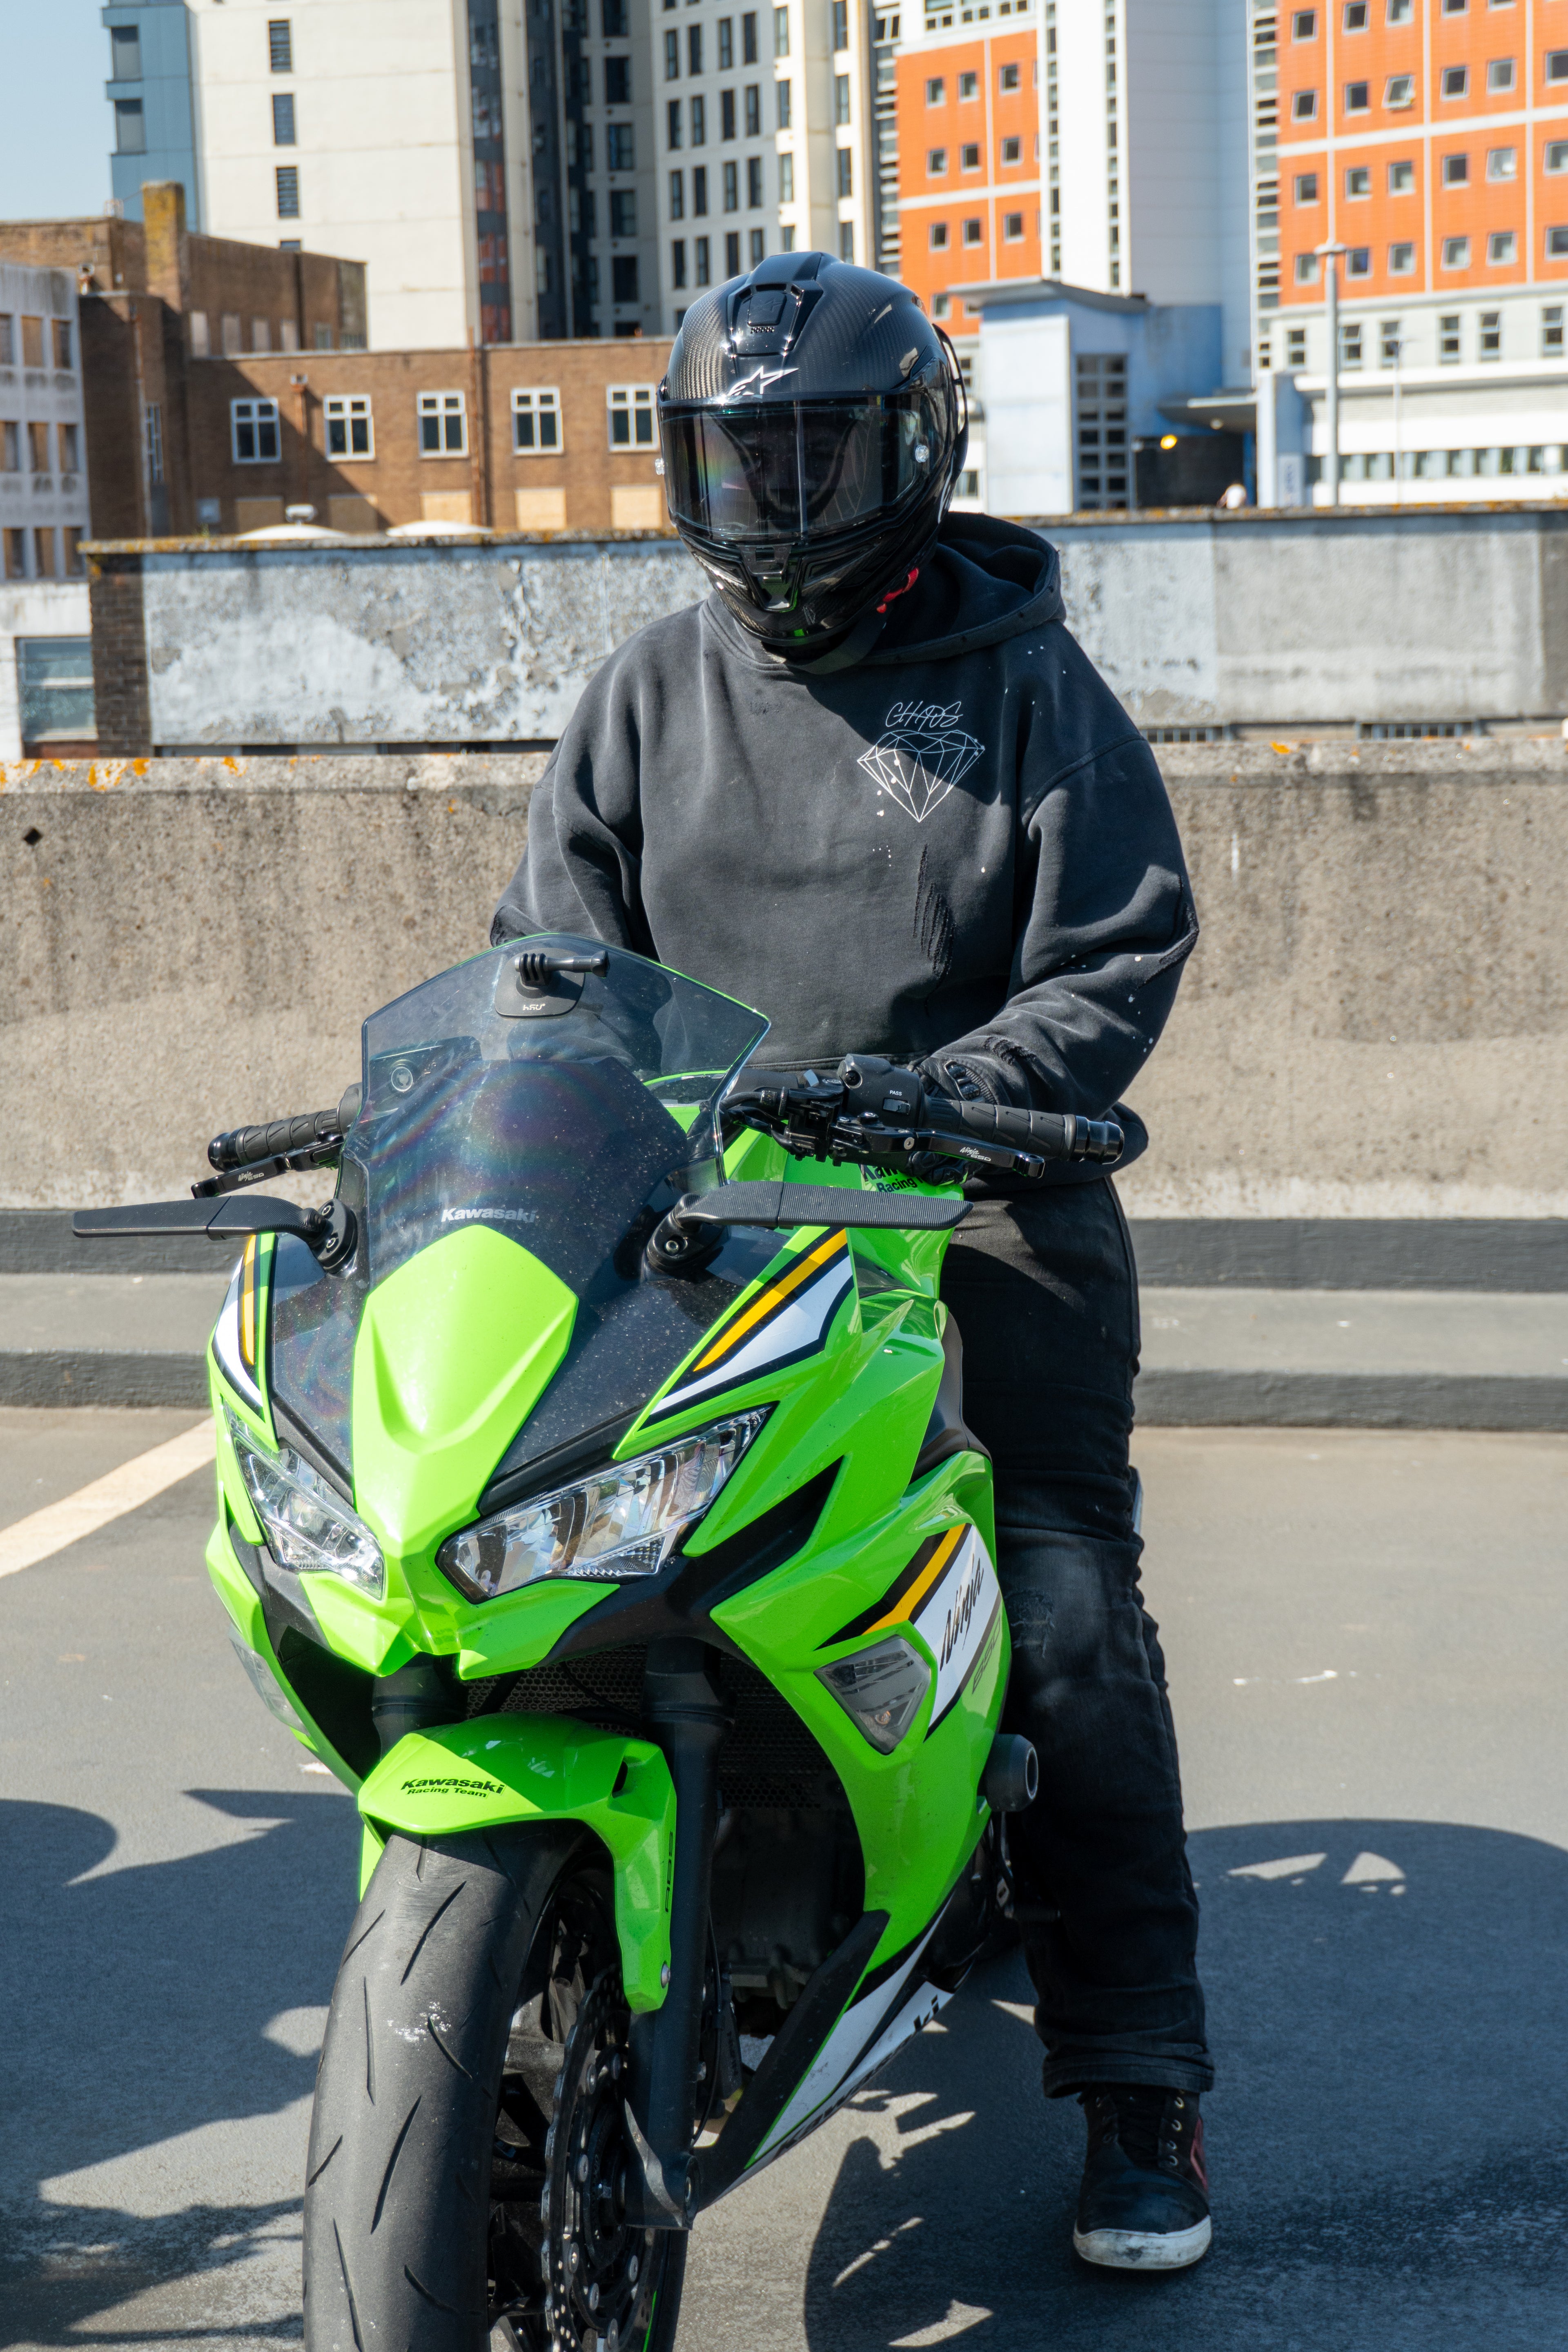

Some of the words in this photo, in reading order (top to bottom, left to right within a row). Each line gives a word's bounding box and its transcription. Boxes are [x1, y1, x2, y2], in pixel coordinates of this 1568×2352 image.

[960, 1147, 980, 1156] Ninja
[238, 1171, 253, 1181] Ninja
[876, 1177, 918, 1193] Racing
[441, 1208, 536, 1223] Kawasaki
[940, 1553, 984, 1671] Ninja
[972, 1614, 1000, 1694] 650
[401, 1779, 505, 1794] Kawasaki
[454, 1788, 487, 1797] Team
[665, 1831, 673, 1912] ABS
